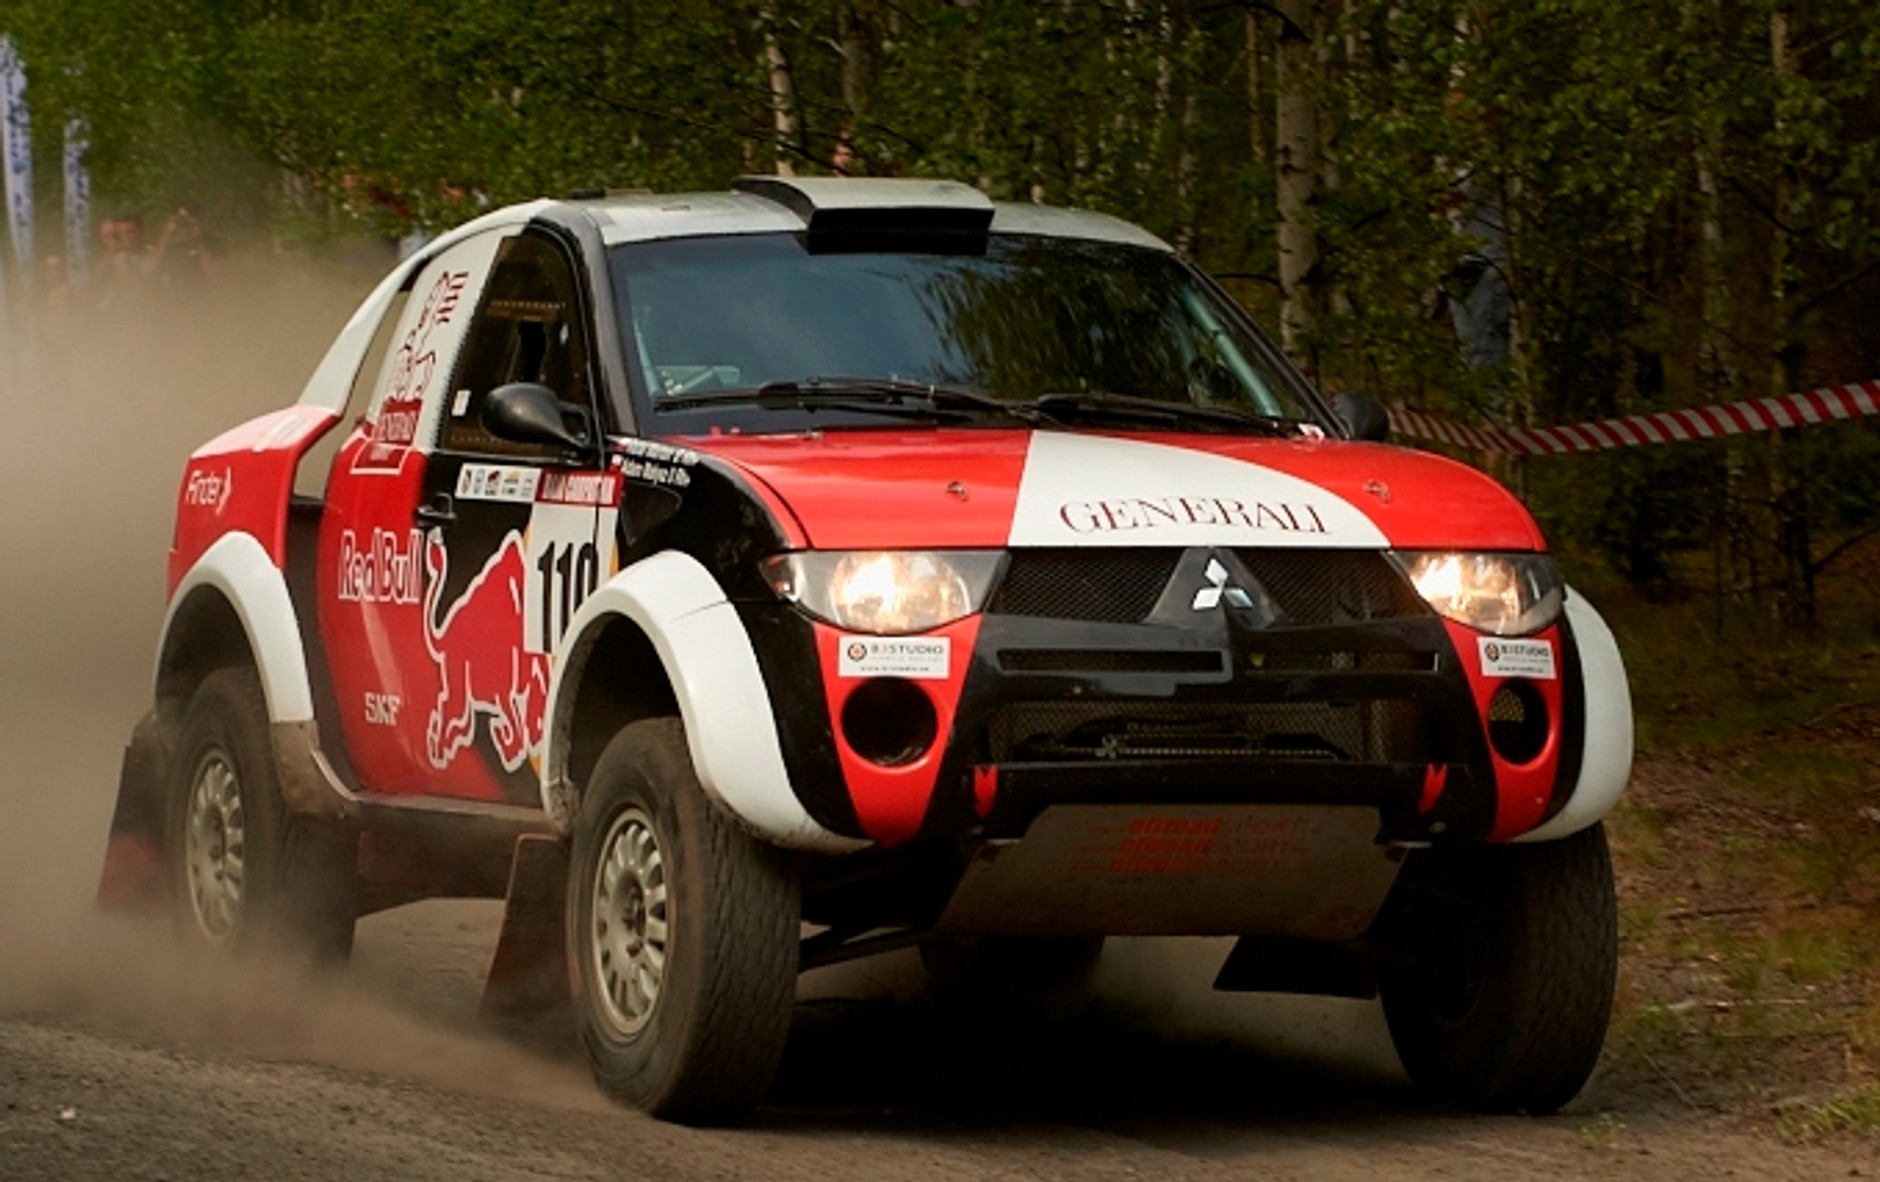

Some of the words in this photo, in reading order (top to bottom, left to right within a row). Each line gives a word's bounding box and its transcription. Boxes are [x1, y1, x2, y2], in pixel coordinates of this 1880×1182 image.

[1058, 497, 1332, 535] GENERALI
[338, 527, 380, 602] Red
[377, 528, 423, 604] Bull
[365, 691, 400, 726] SKF
